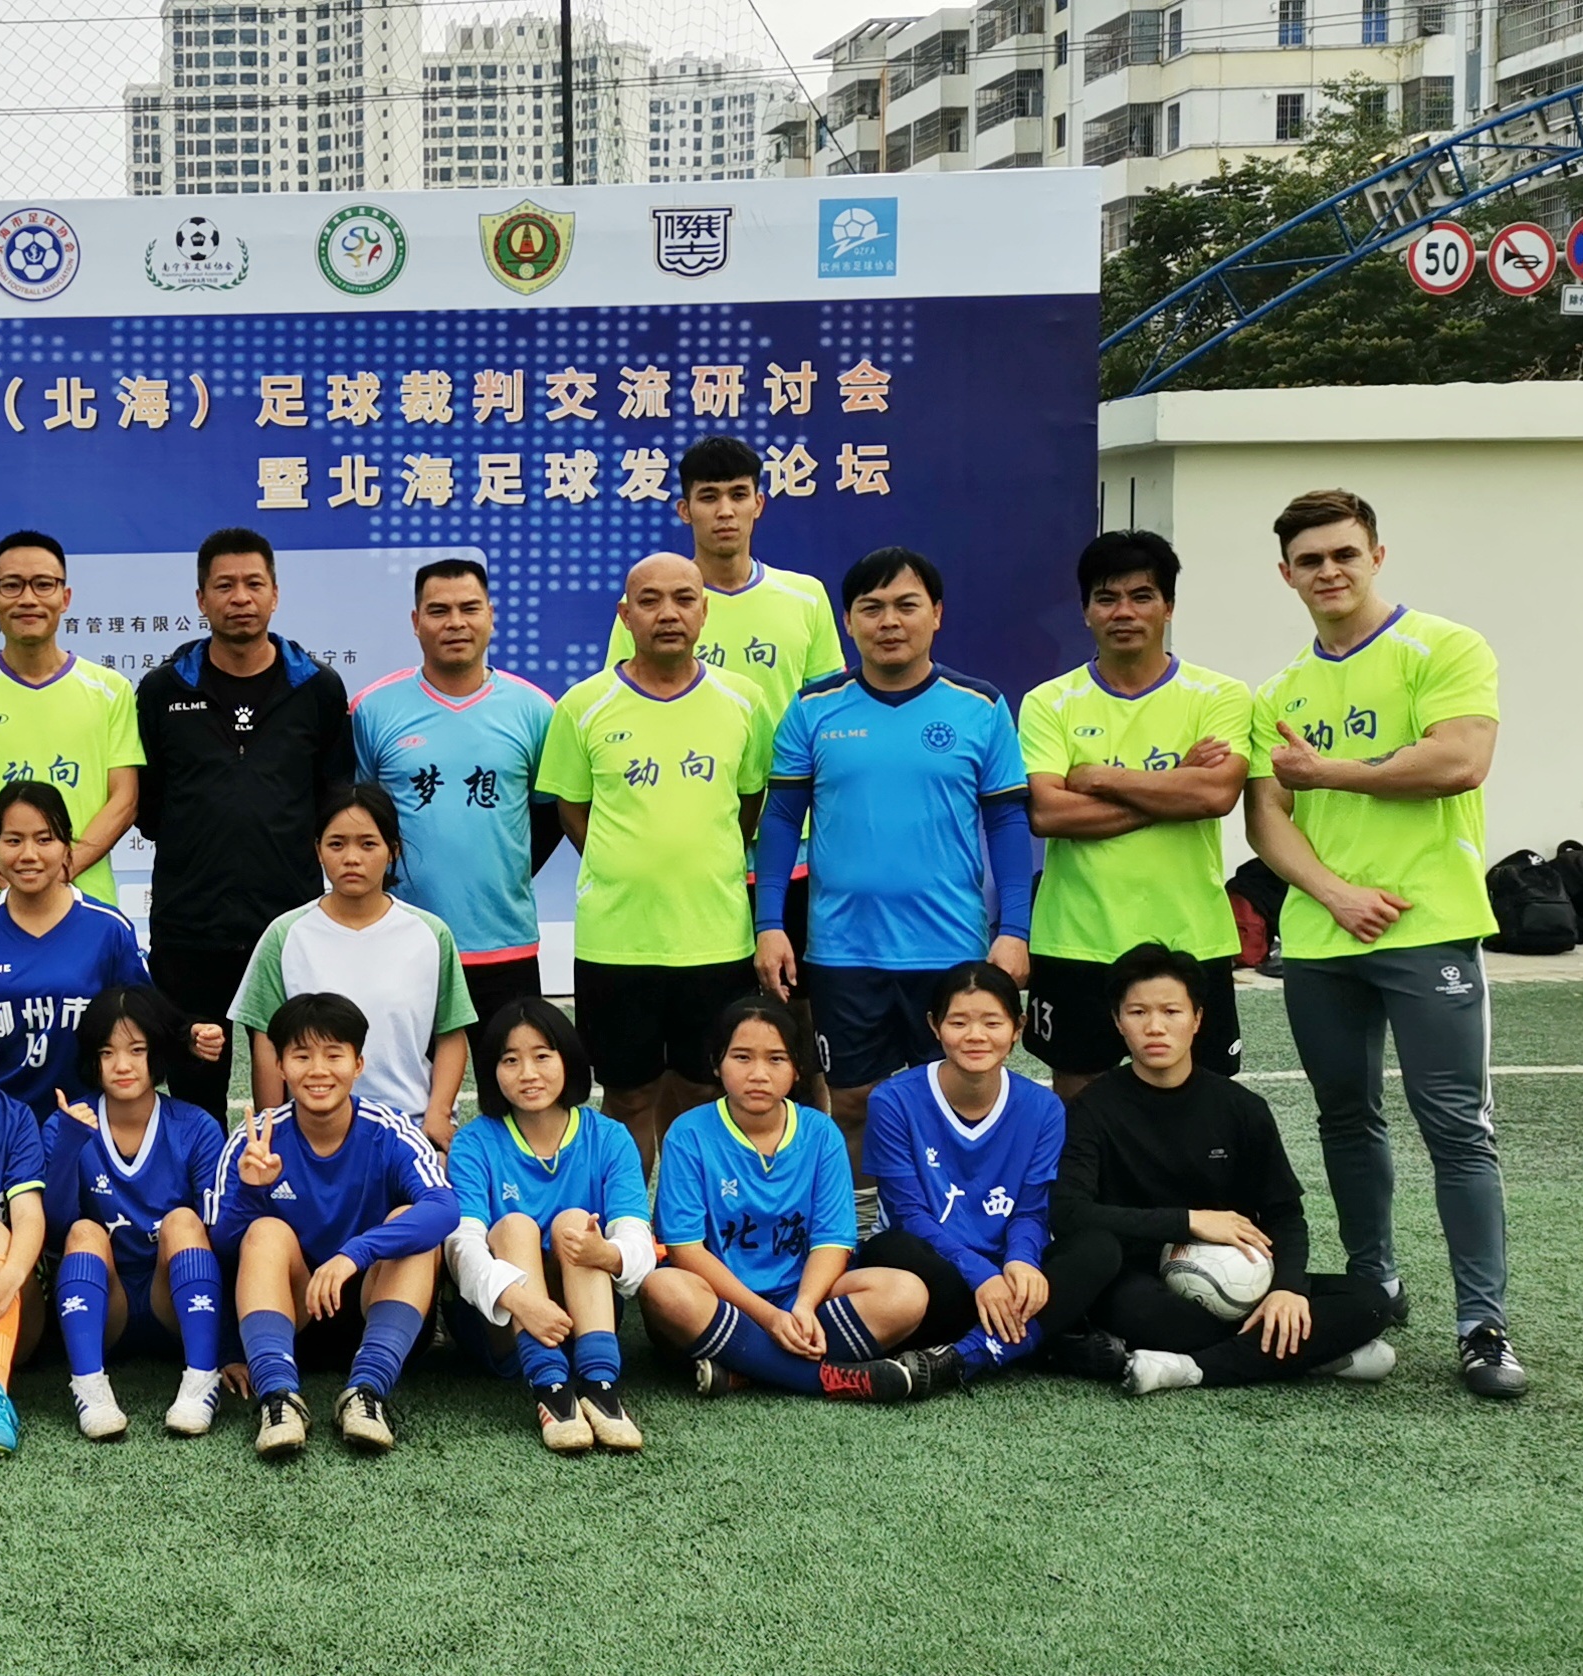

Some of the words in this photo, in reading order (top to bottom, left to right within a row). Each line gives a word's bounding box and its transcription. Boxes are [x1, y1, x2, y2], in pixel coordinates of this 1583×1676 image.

[7, 280, 41, 296] FOOTBALL
[42, 257, 75, 295] ASSOCIATION
[1424, 242, 1459, 276] 50
[255, 358, 894, 430] 足球裁判交流研讨会
[255, 441, 893, 511] 暨北海足球发论坛
[693, 636, 777, 669] 动向
[168, 700, 209, 713] KELME
[820, 728, 869, 741] KELME
[1301, 704, 1378, 753] 动向
[1, 753, 80, 789] 动向
[410, 763, 501, 813] 梦想
[624, 749, 715, 789] 动向
[1031, 997, 1054, 1042] 13
[21, 1032, 50, 1069] 19
[939, 1183, 1015, 1224] 广西
[720, 1210, 805, 1257] 北海
